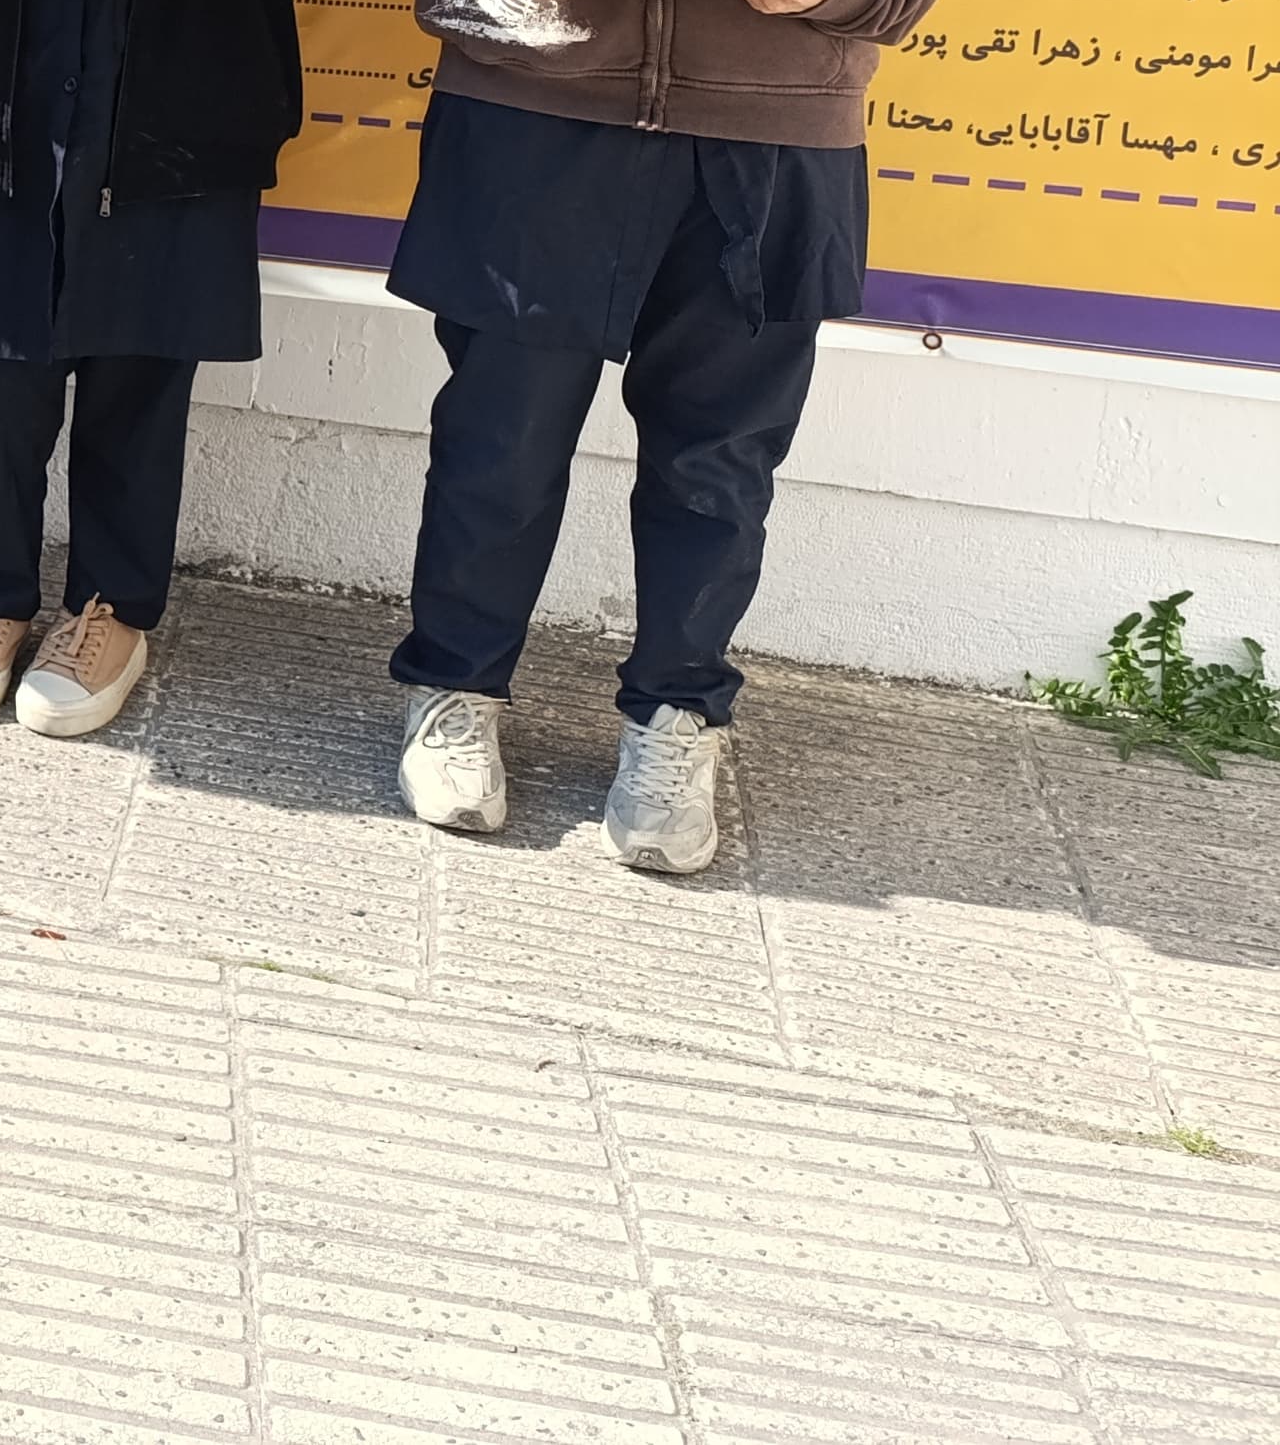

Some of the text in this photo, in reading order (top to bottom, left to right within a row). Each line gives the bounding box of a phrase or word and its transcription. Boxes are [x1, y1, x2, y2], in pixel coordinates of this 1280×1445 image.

[901, 27, 1233, 77] مومنی زهرا تقی پور
[1120, 121, 1198, 161] مهسا
